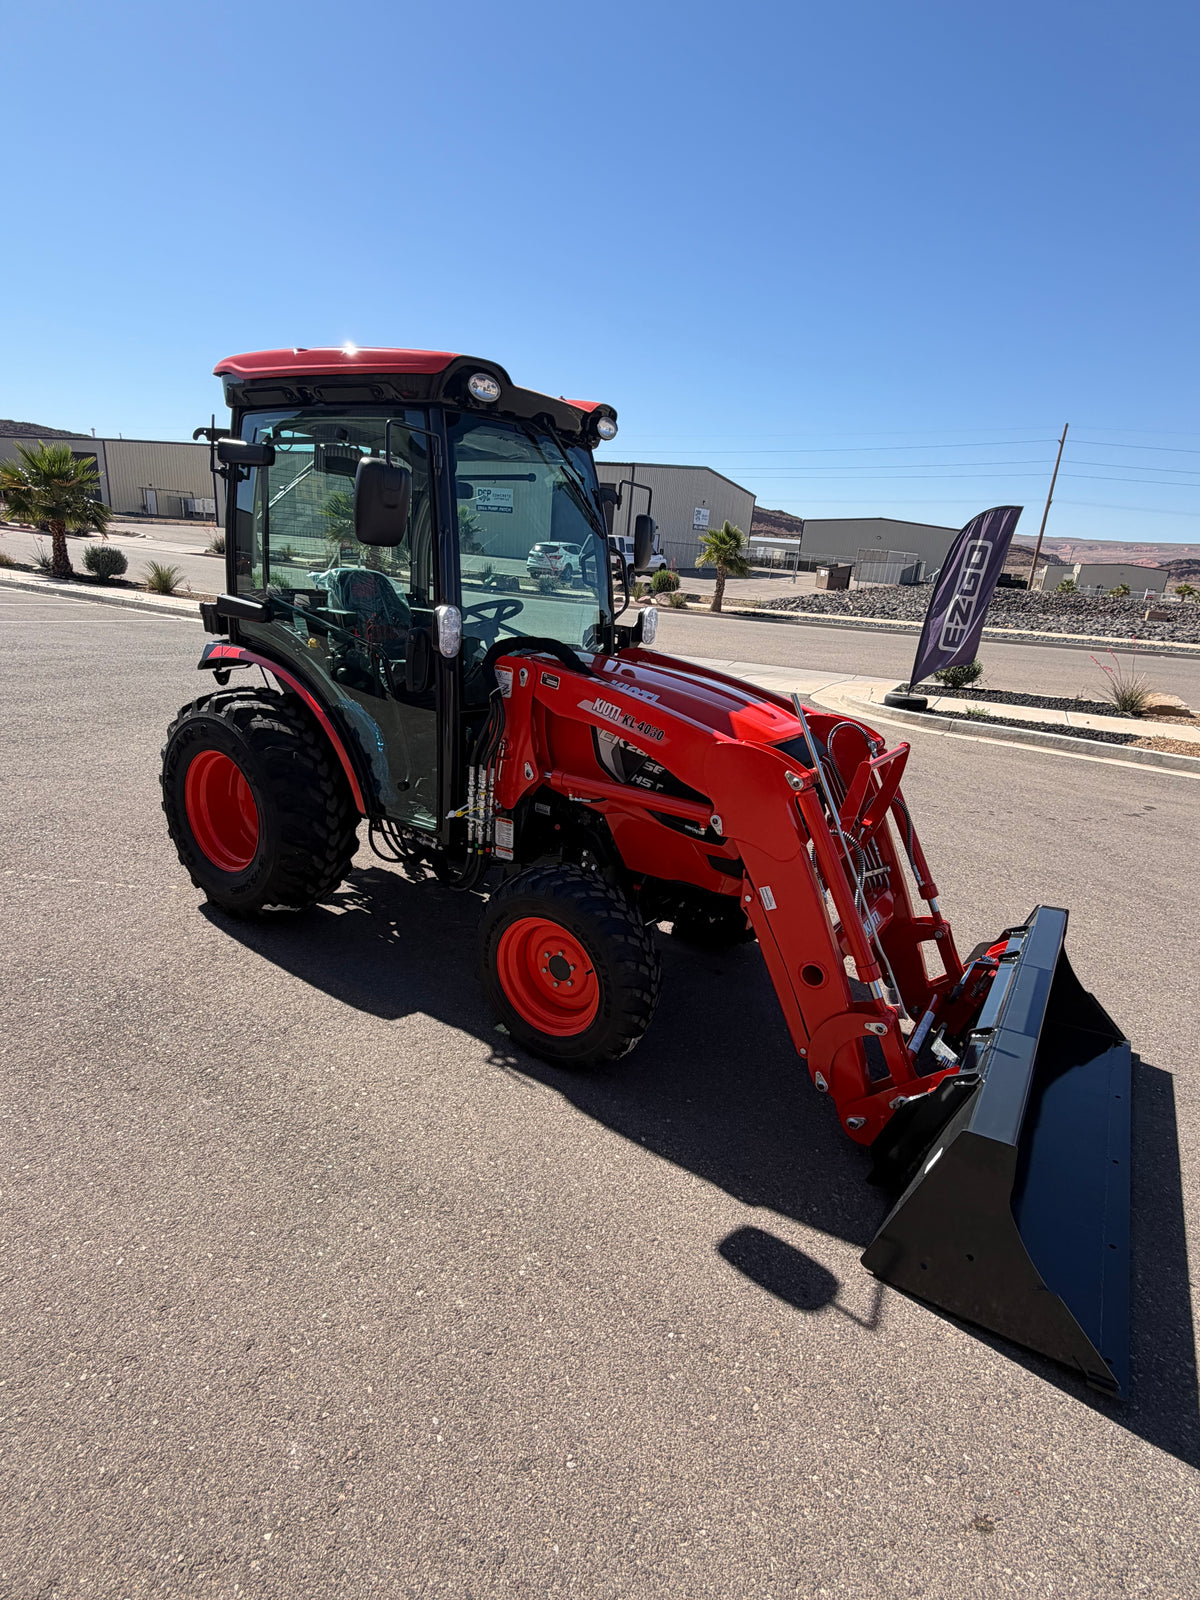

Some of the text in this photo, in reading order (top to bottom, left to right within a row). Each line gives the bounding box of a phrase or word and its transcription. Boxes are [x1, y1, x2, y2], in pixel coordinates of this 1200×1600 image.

[592, 697, 665, 741] KIOTI KL 4030
[642, 761, 665, 775] SE
